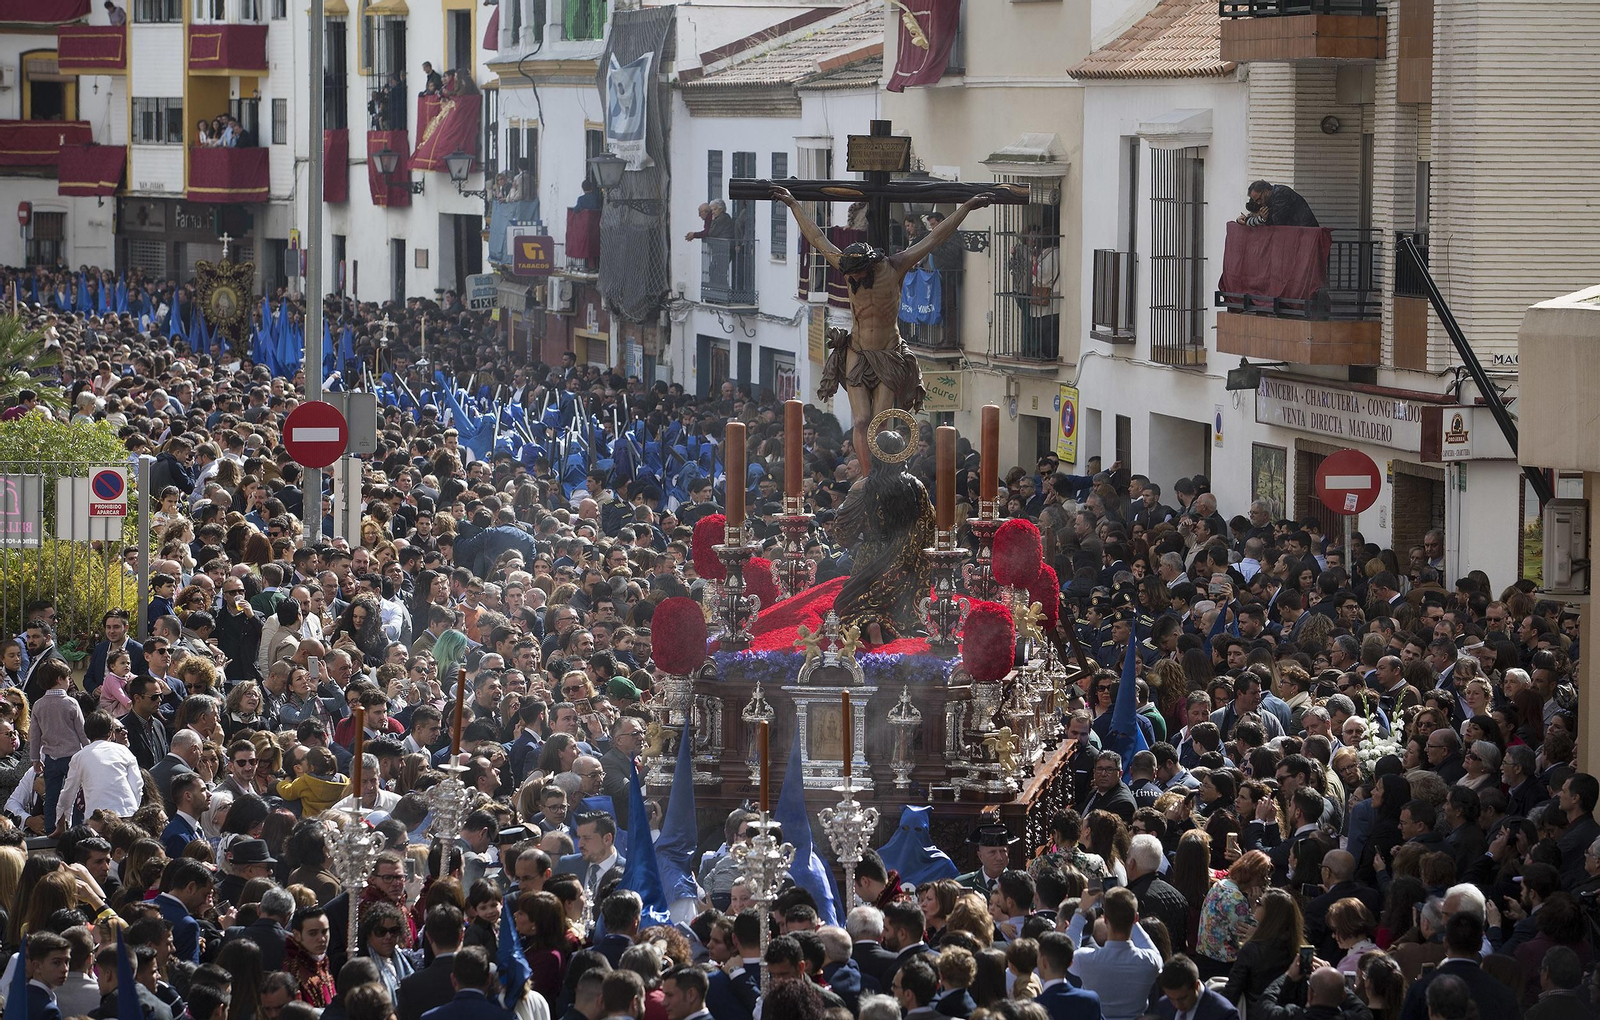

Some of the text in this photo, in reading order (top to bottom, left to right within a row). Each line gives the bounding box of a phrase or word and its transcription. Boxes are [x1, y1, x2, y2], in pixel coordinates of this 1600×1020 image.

[926, 381, 958, 402] Laurel
[1257, 381, 1299, 402] ARNICERIA
[1305, 389, 1360, 413] CHARCUTERIA
[1282, 406, 1393, 442] VENTA DIRECTA MATADERO
